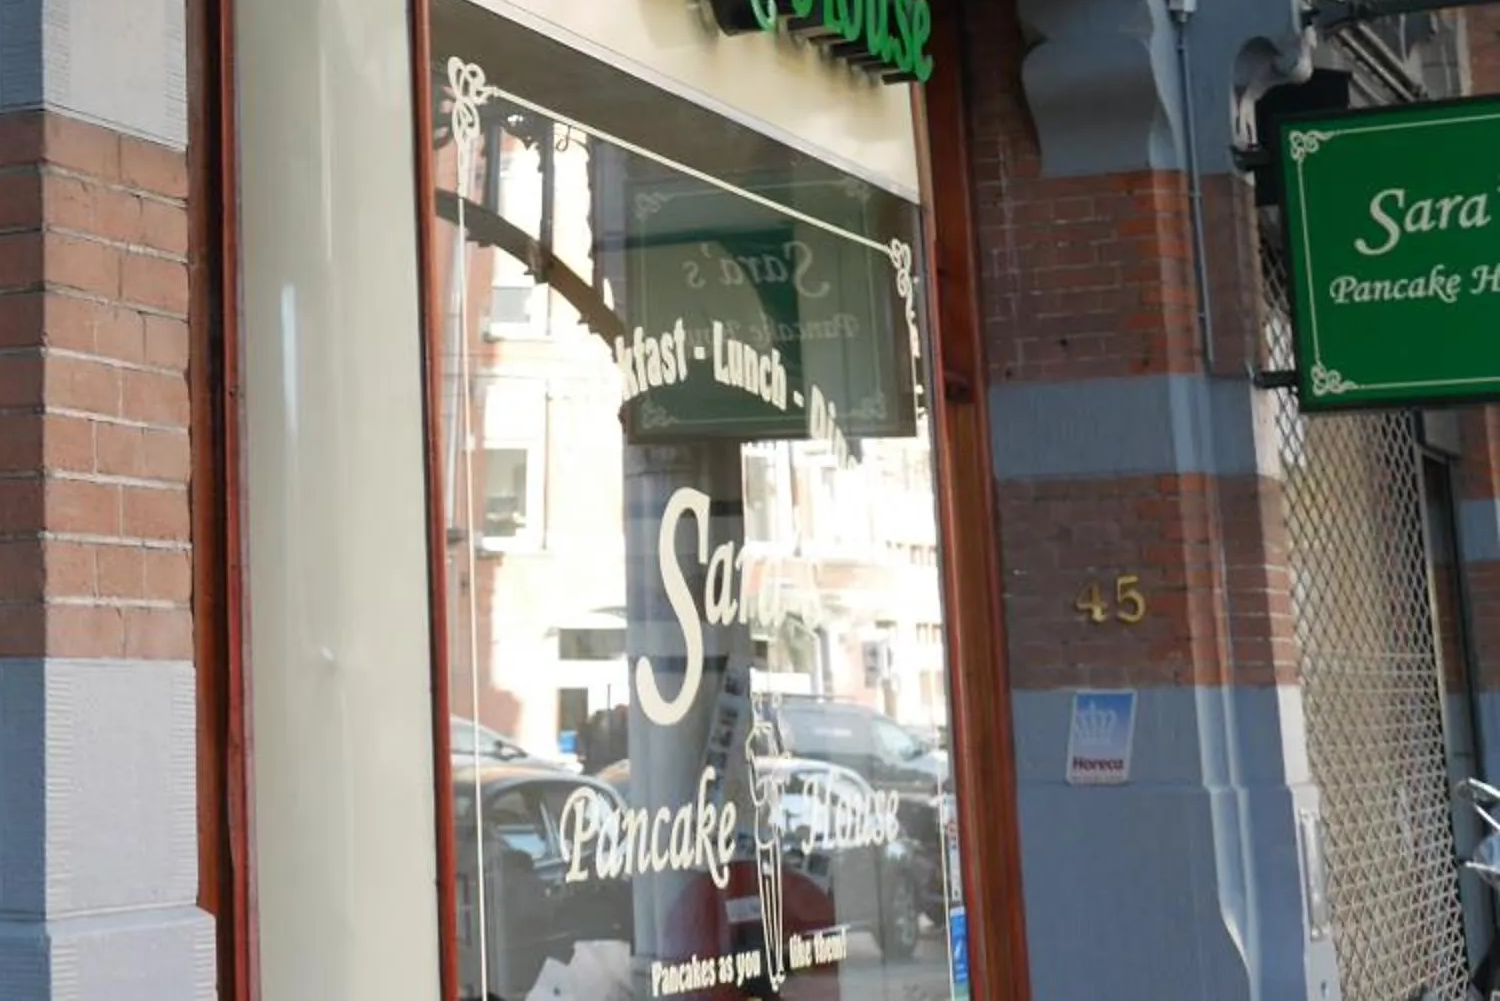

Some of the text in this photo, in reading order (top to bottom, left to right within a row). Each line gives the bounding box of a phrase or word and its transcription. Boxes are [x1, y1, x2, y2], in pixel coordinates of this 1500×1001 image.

[1353, 175, 1500, 256] Sara
[1329, 263, 1462, 304] Pancake
[613, 317, 688, 402] kfast
[712, 320, 787, 411] Lunch
[1075, 575, 1147, 623] 45
[559, 766, 739, 889] Pancake
[800, 771, 901, 856] House
[651, 953, 717, 997] Pancakes
[718, 952, 734, 984] as
[735, 949, 762, 987] you
[789, 931, 813, 970] like
